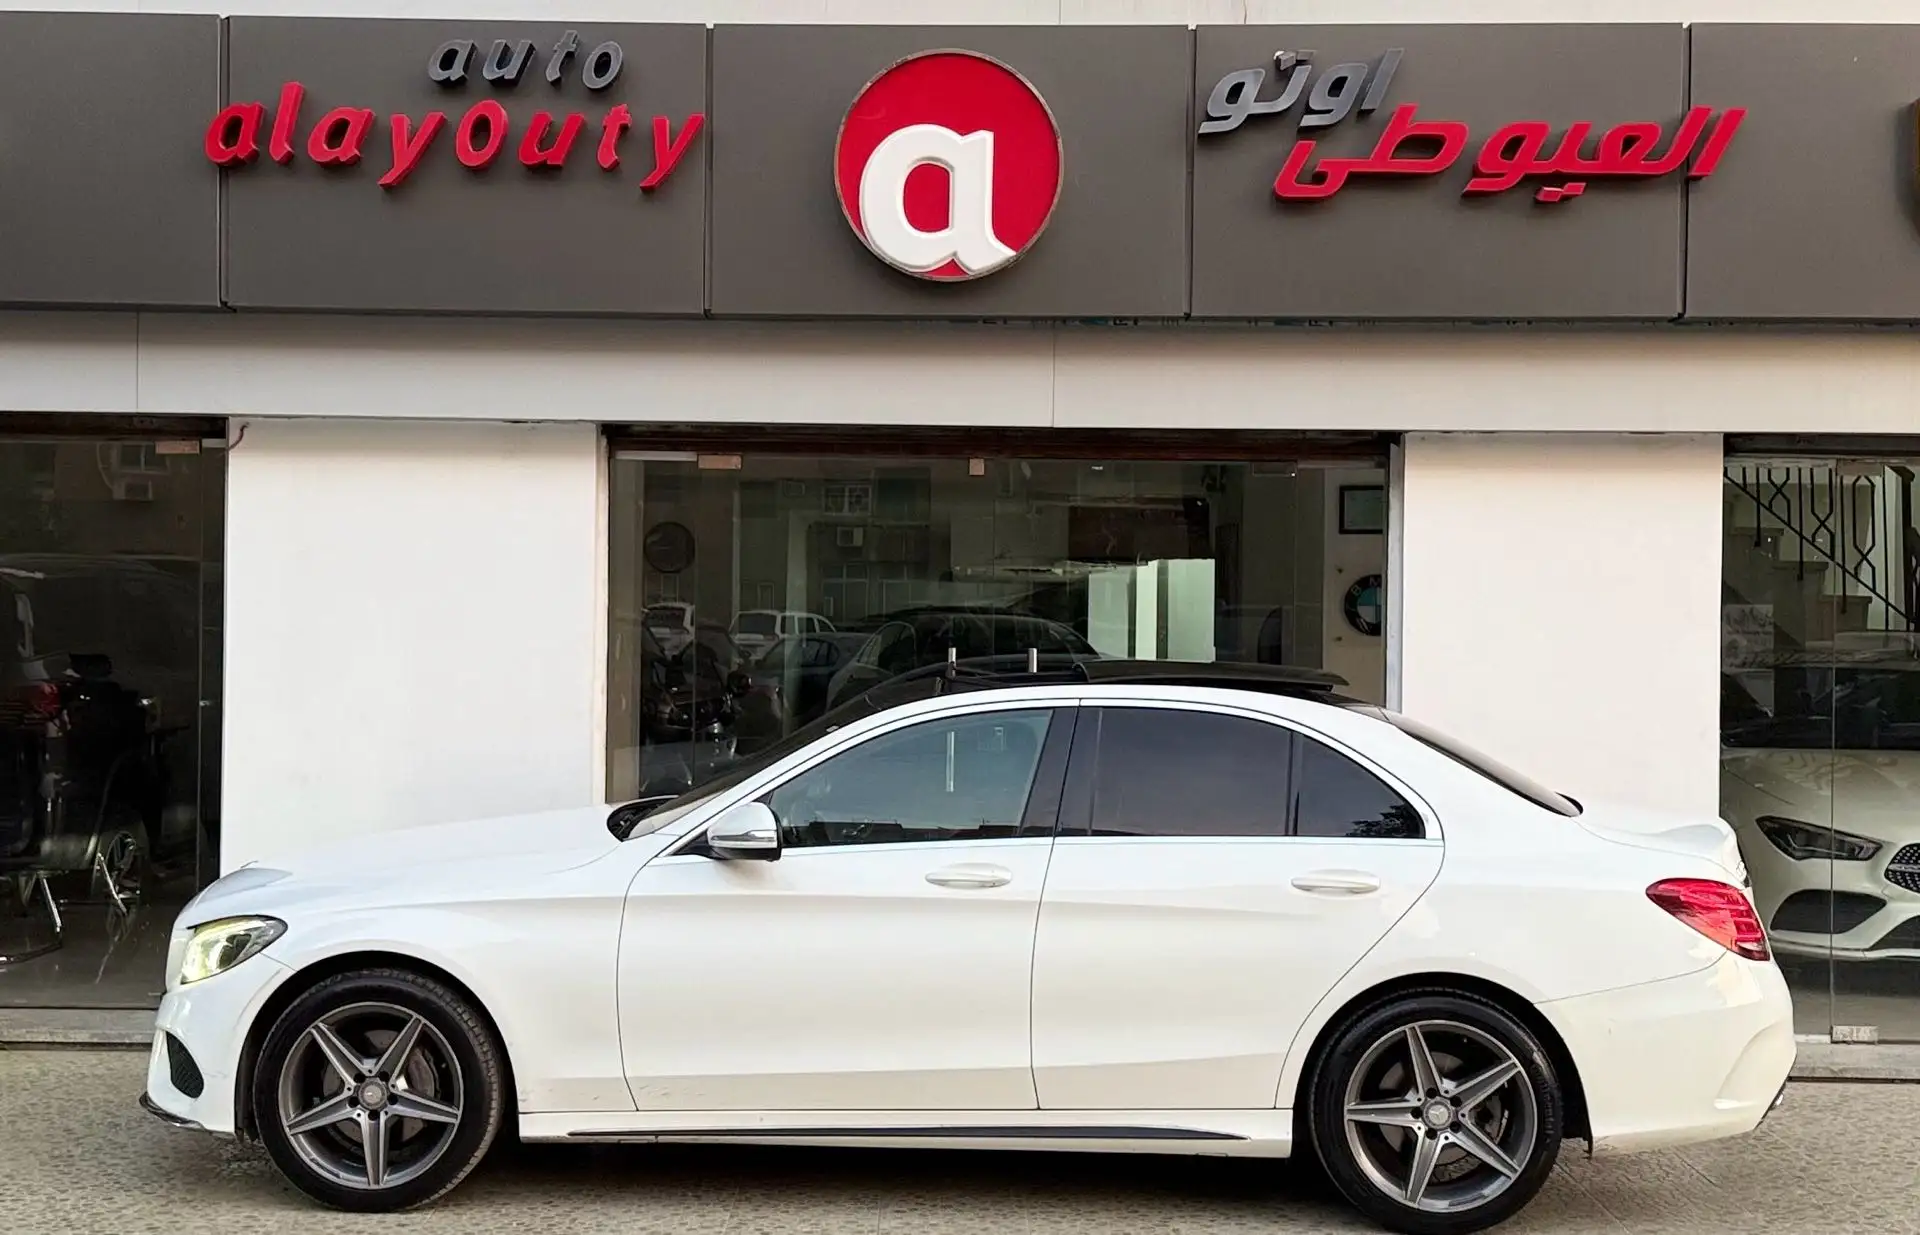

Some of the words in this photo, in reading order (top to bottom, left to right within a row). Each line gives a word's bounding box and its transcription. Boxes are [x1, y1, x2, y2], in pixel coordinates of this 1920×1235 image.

[428, 29, 624, 90] auto
[1198, 48, 1404, 134] اوتو
[204, 81, 705, 191] alayouty
[859, 124, 1017, 275] a
